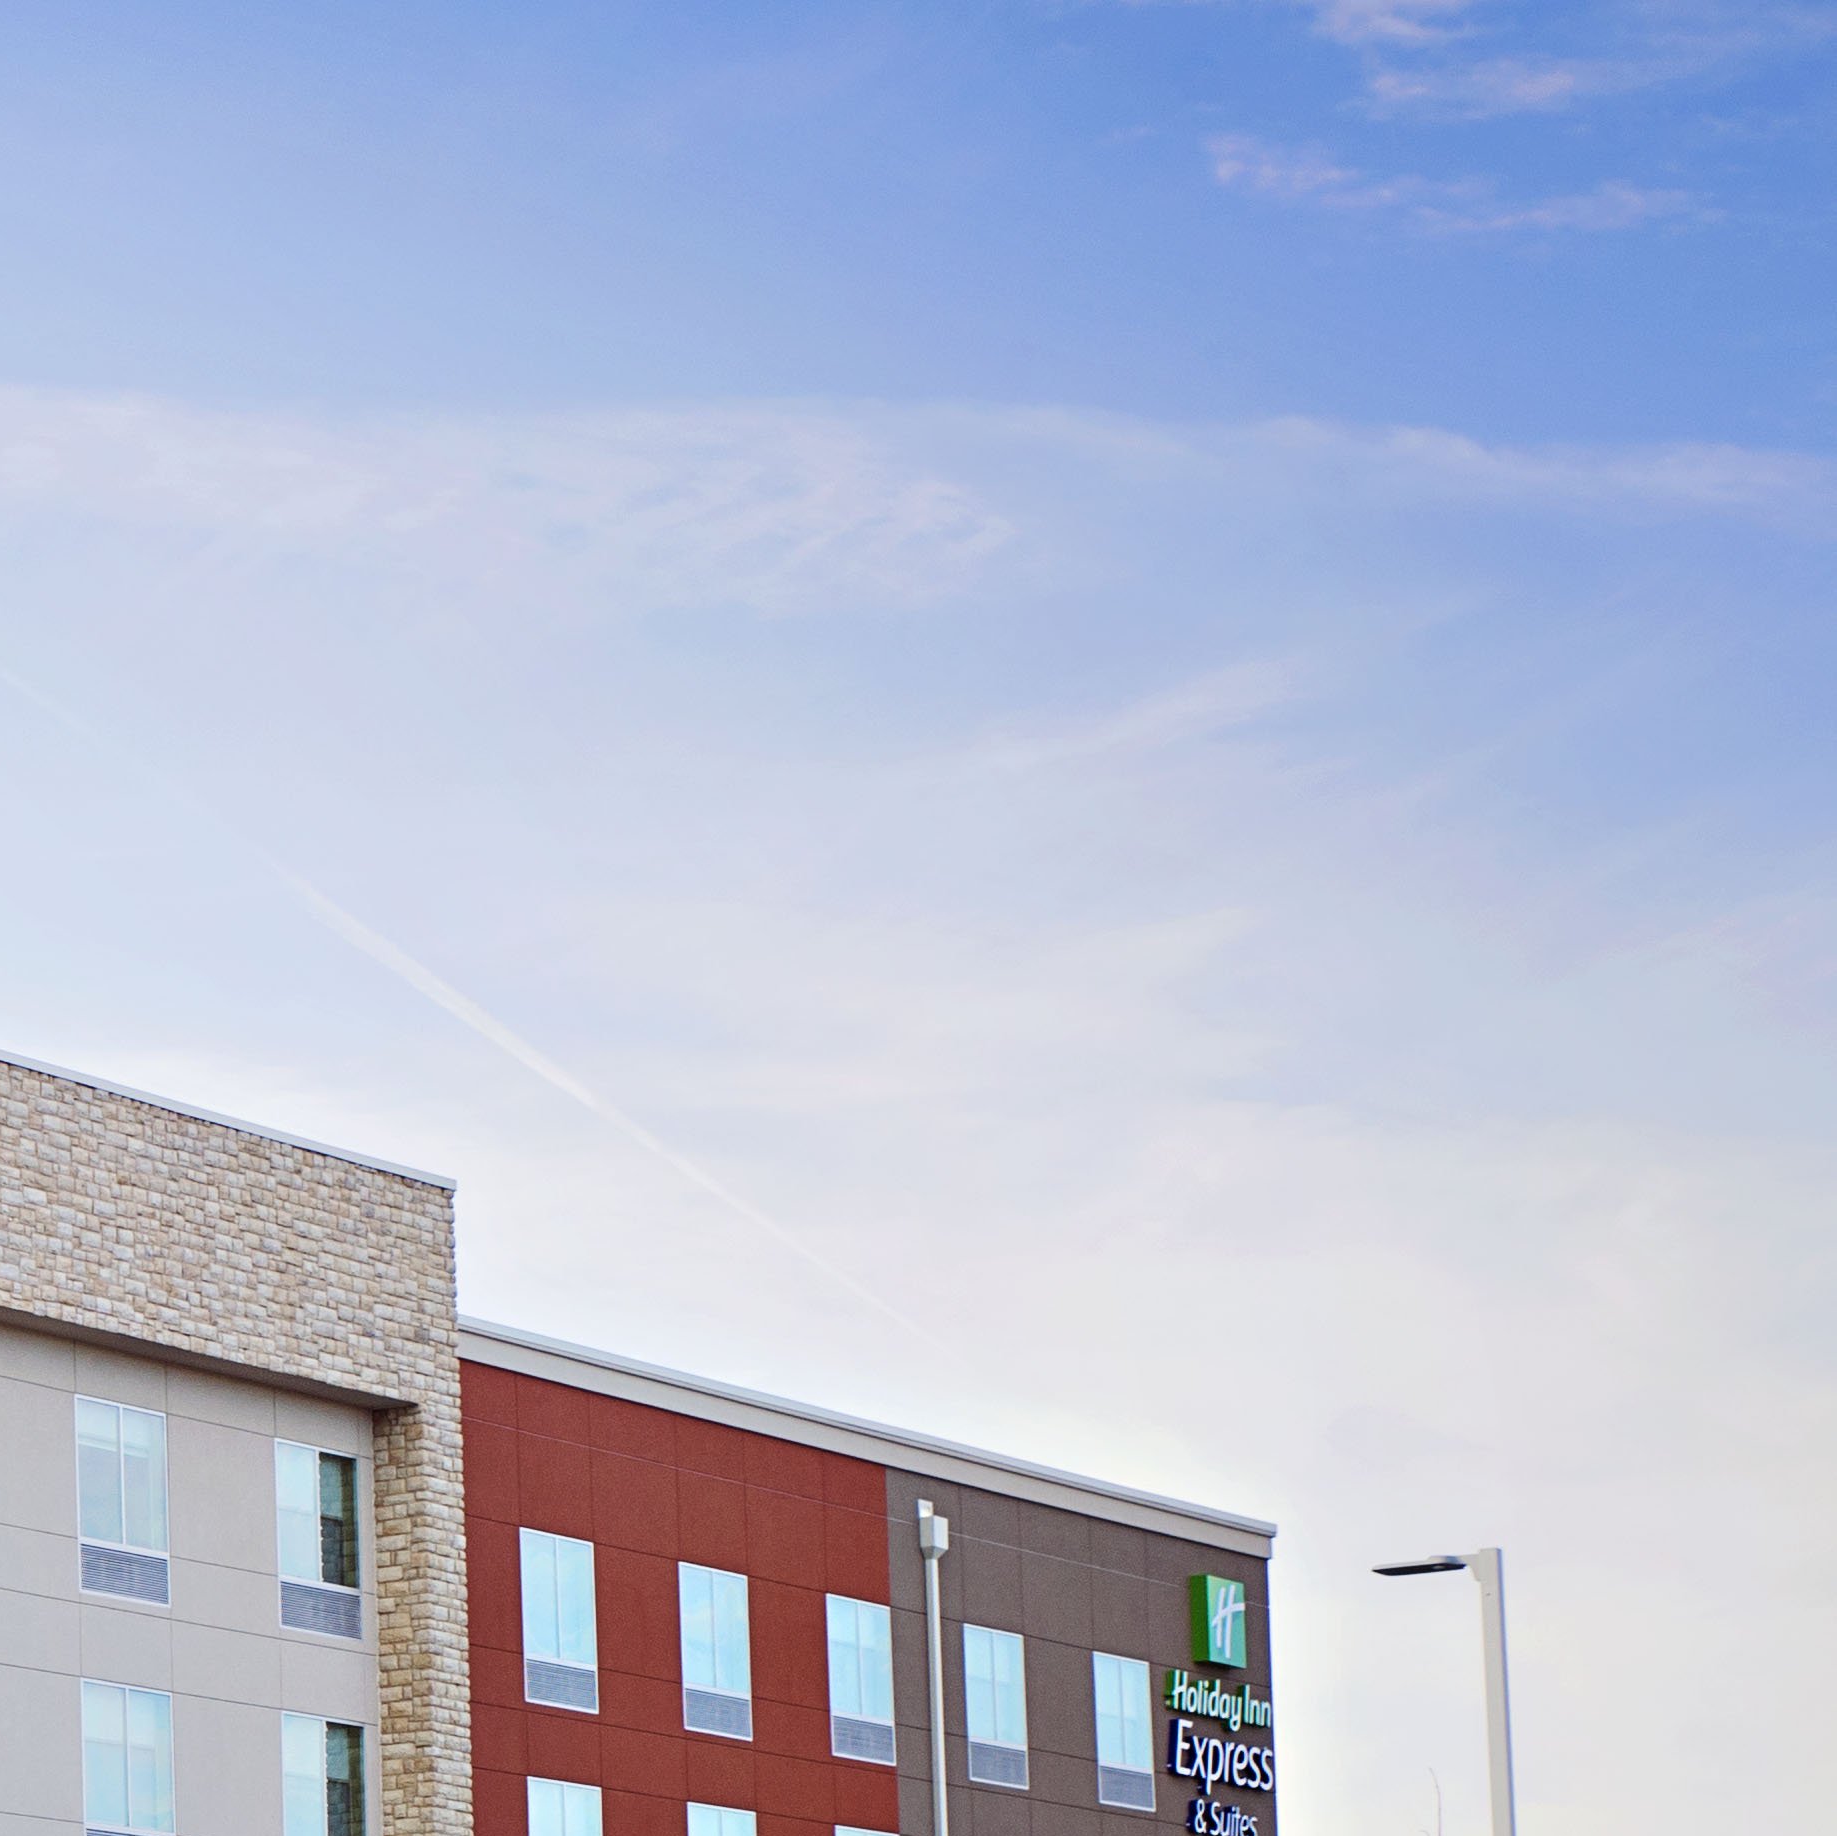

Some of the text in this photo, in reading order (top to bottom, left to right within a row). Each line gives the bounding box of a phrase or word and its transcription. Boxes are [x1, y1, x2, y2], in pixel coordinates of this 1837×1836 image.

[1171, 1668, 1272, 1732] Holiday Inn
[1175, 1718, 1274, 1796] Express
[1194, 1798, 1207, 1834] &
